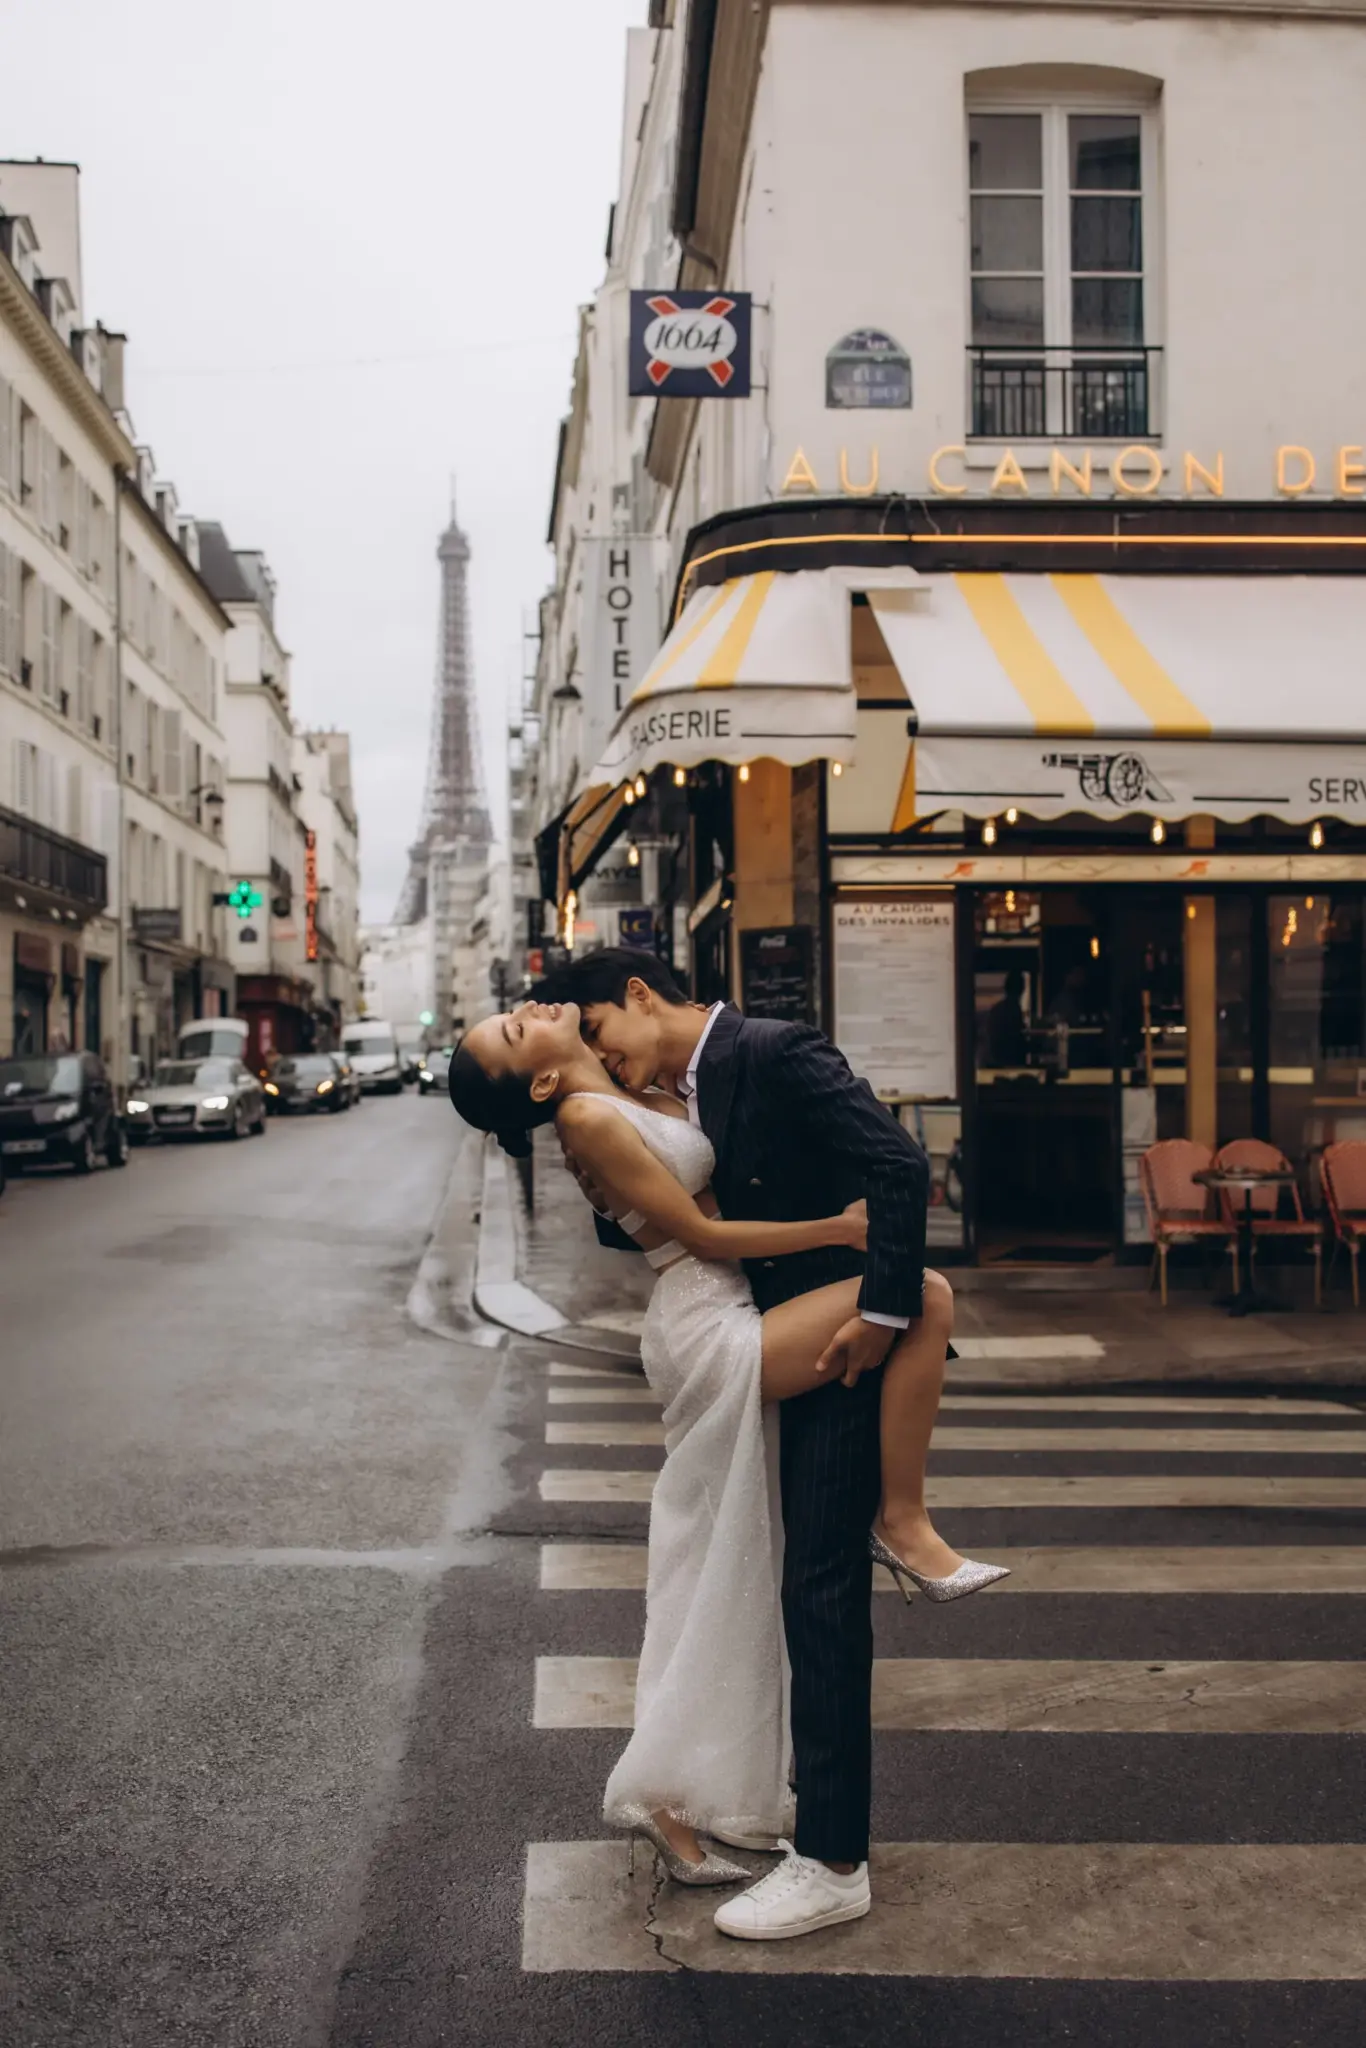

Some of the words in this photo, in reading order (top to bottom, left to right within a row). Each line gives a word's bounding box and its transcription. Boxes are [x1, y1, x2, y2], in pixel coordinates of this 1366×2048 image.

[654, 321, 724, 353] 1664
[782, 445, 879, 496] AU
[928, 445, 1223, 496] CANON
[1276, 445, 1366, 496] DE
[853, 903, 874, 914] AU
[880, 903, 935, 913] CANON
[837, 916, 867, 926] DES
[871, 916, 951, 926] INVALIDES
